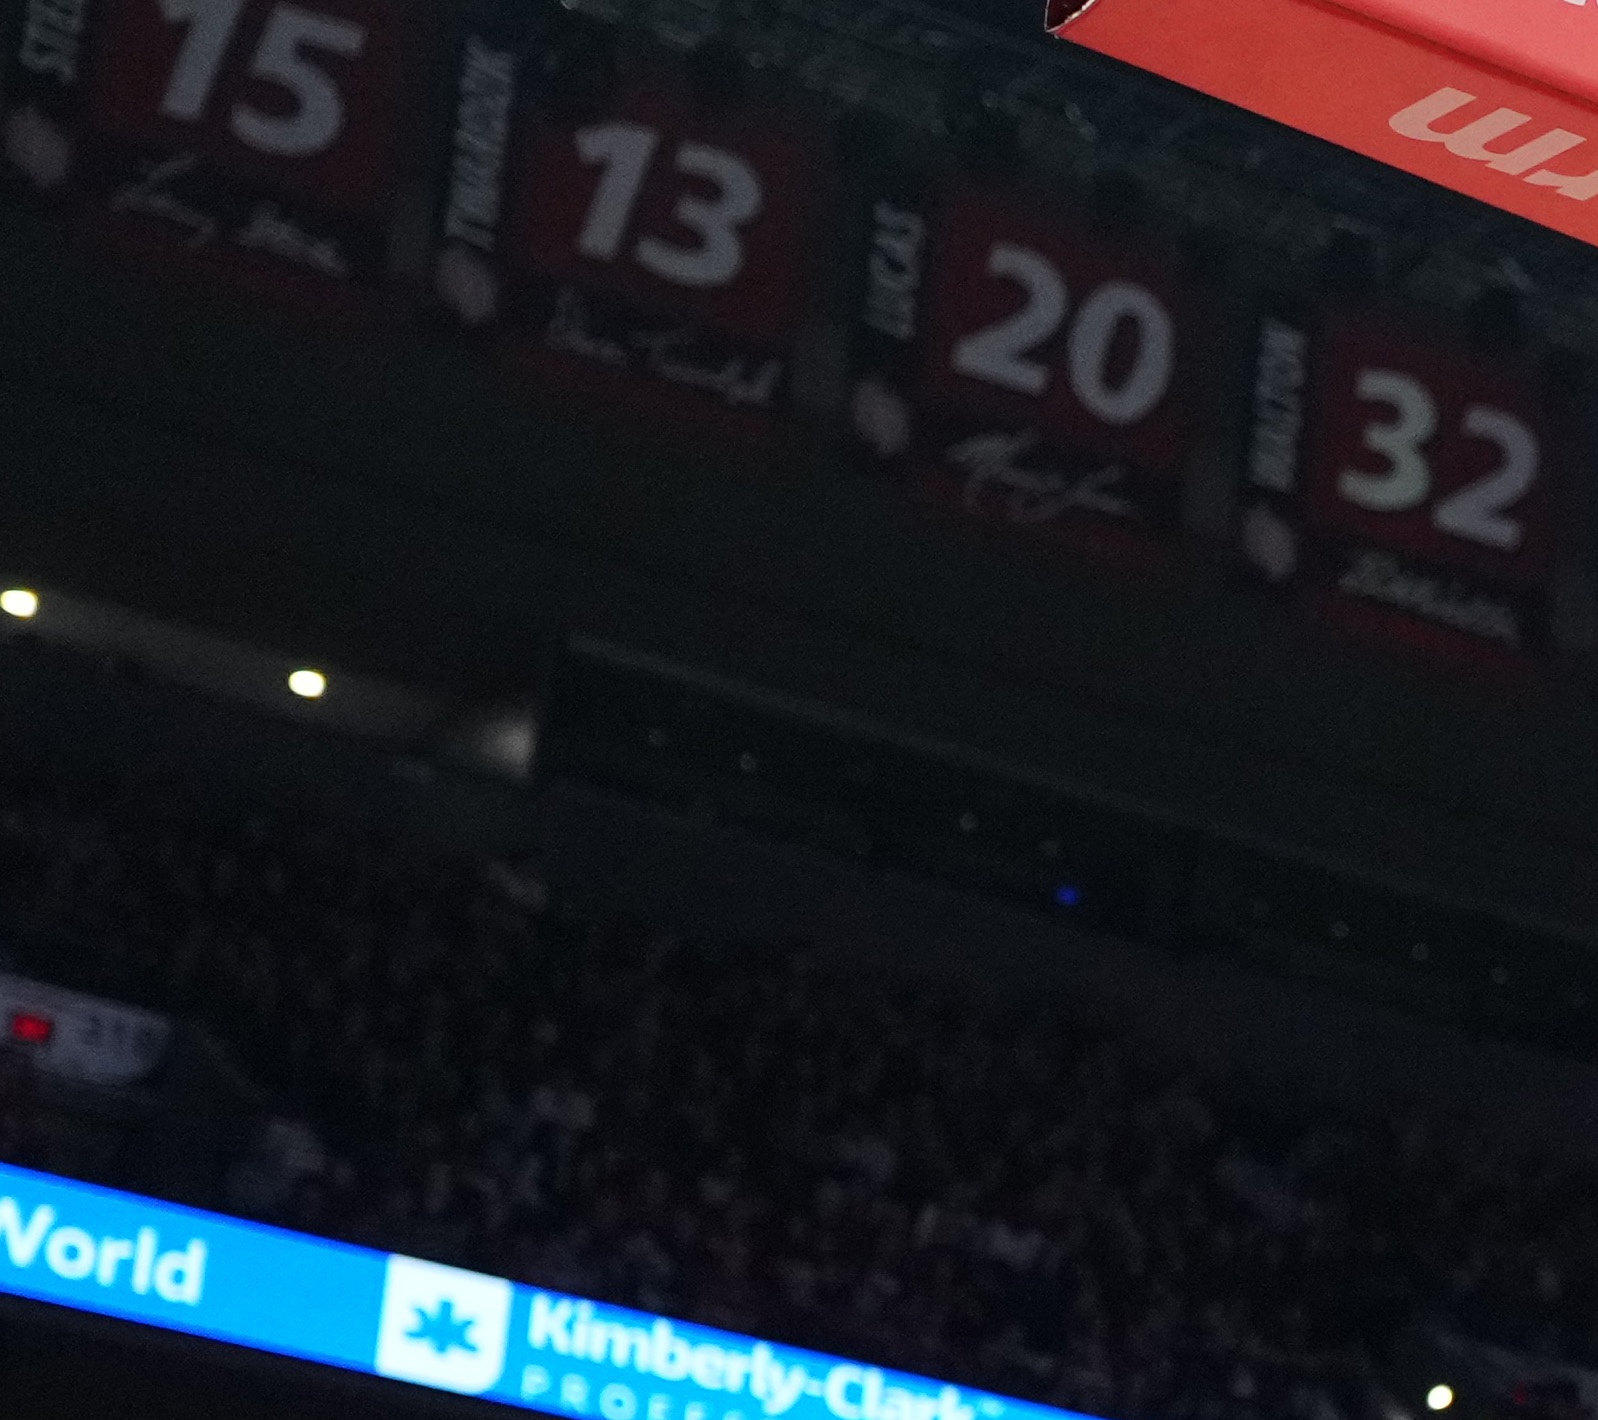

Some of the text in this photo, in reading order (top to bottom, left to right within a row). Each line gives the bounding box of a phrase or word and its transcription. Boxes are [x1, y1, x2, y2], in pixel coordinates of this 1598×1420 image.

[156, 0, 367, 156] 15
[573, 121, 763, 287] 13
[951, 242, 1175, 425] 20
[1337, 368, 1541, 550] 32
